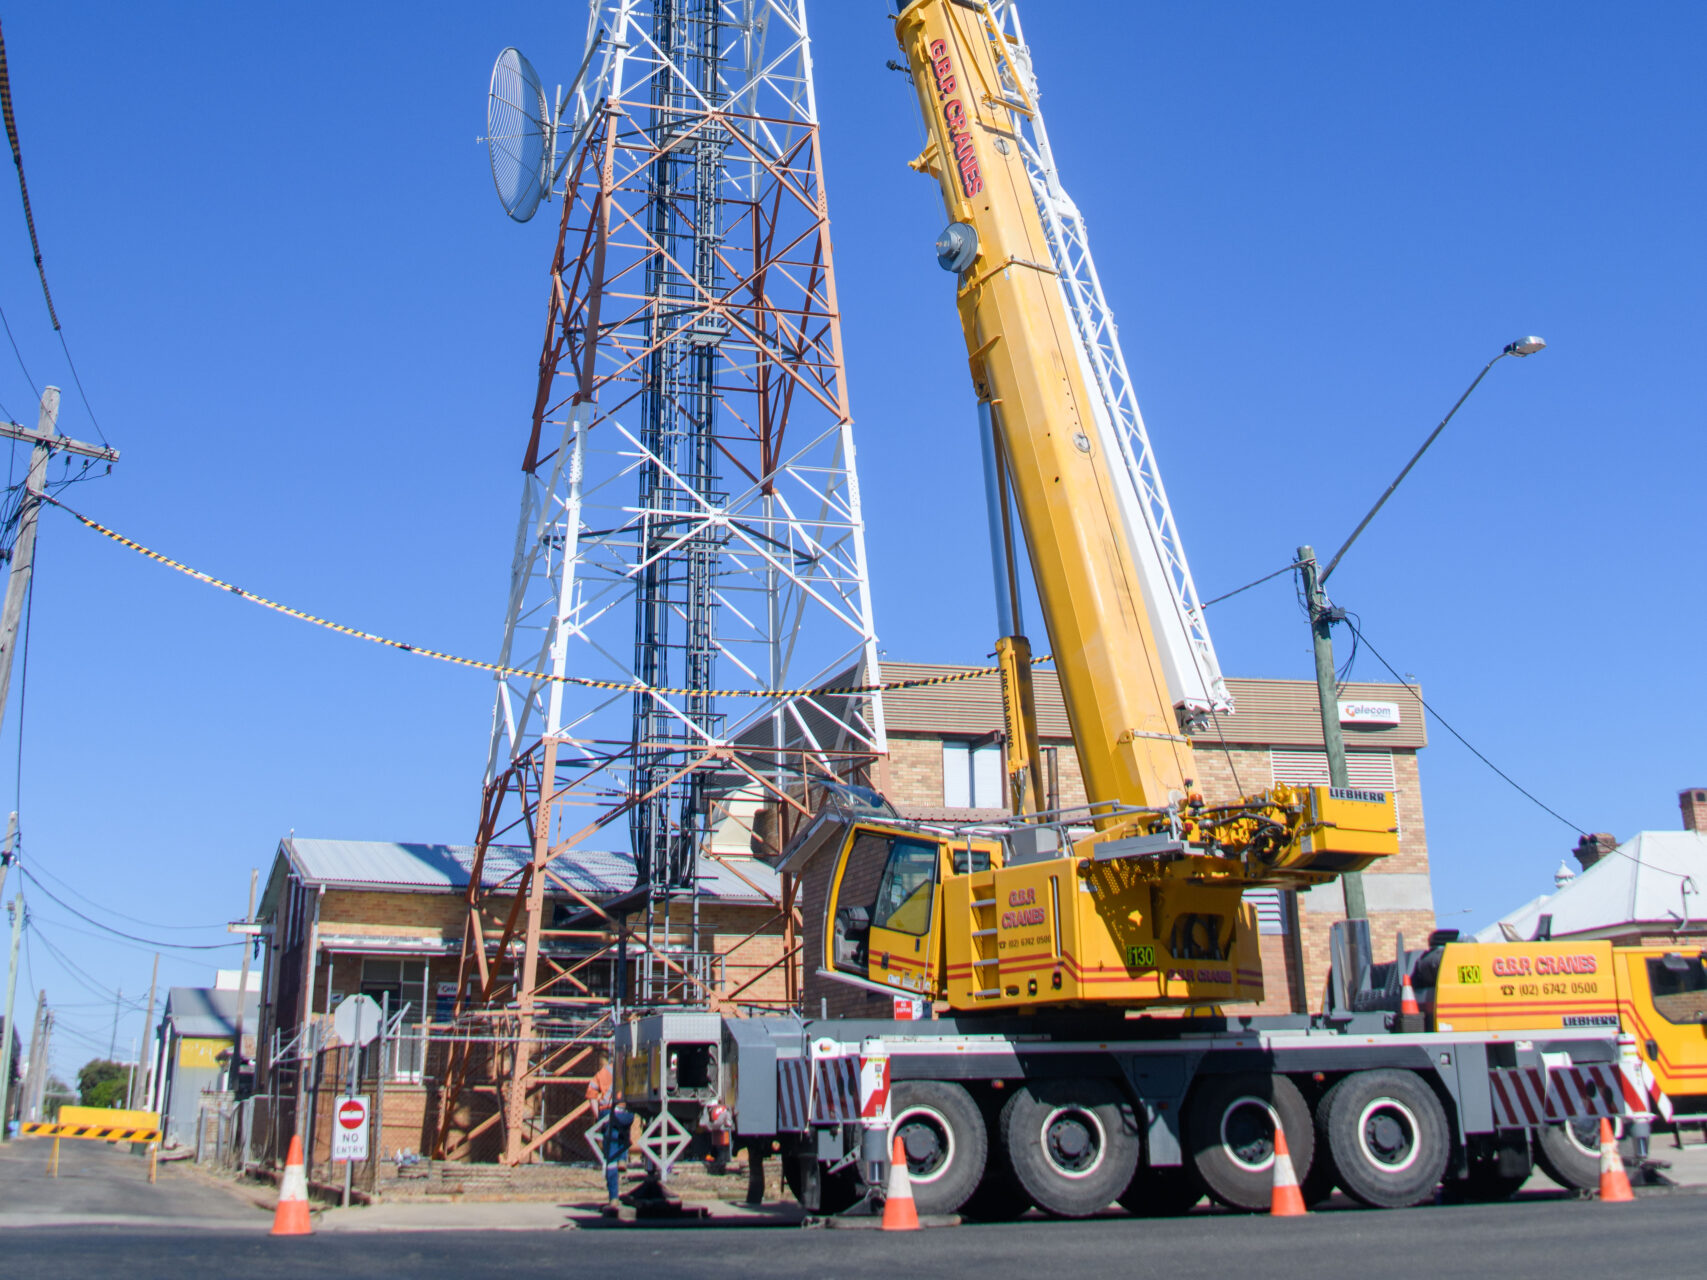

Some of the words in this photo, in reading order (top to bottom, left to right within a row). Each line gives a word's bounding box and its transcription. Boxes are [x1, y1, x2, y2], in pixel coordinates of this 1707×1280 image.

[930, 38, 958, 101] G.B.P.
[944, 98, 985, 199] CRANES
[1329, 788, 1386, 802] LIEBHERR
[1001, 907, 1045, 929] CRANES
[1132, 947, 1153, 965] 130
[1534, 954, 1597, 975] CRANES
[1462, 966, 1480, 982] 130
[1519, 984, 1539, 997] (02)
[1542, 982, 1567, 994] 6742
[1571, 982, 1598, 994] 0500
[1562, 1015, 1618, 1026] LIEBHERR
[342, 1132, 359, 1143] NO
[336, 1144, 365, 1153] ENTRY
